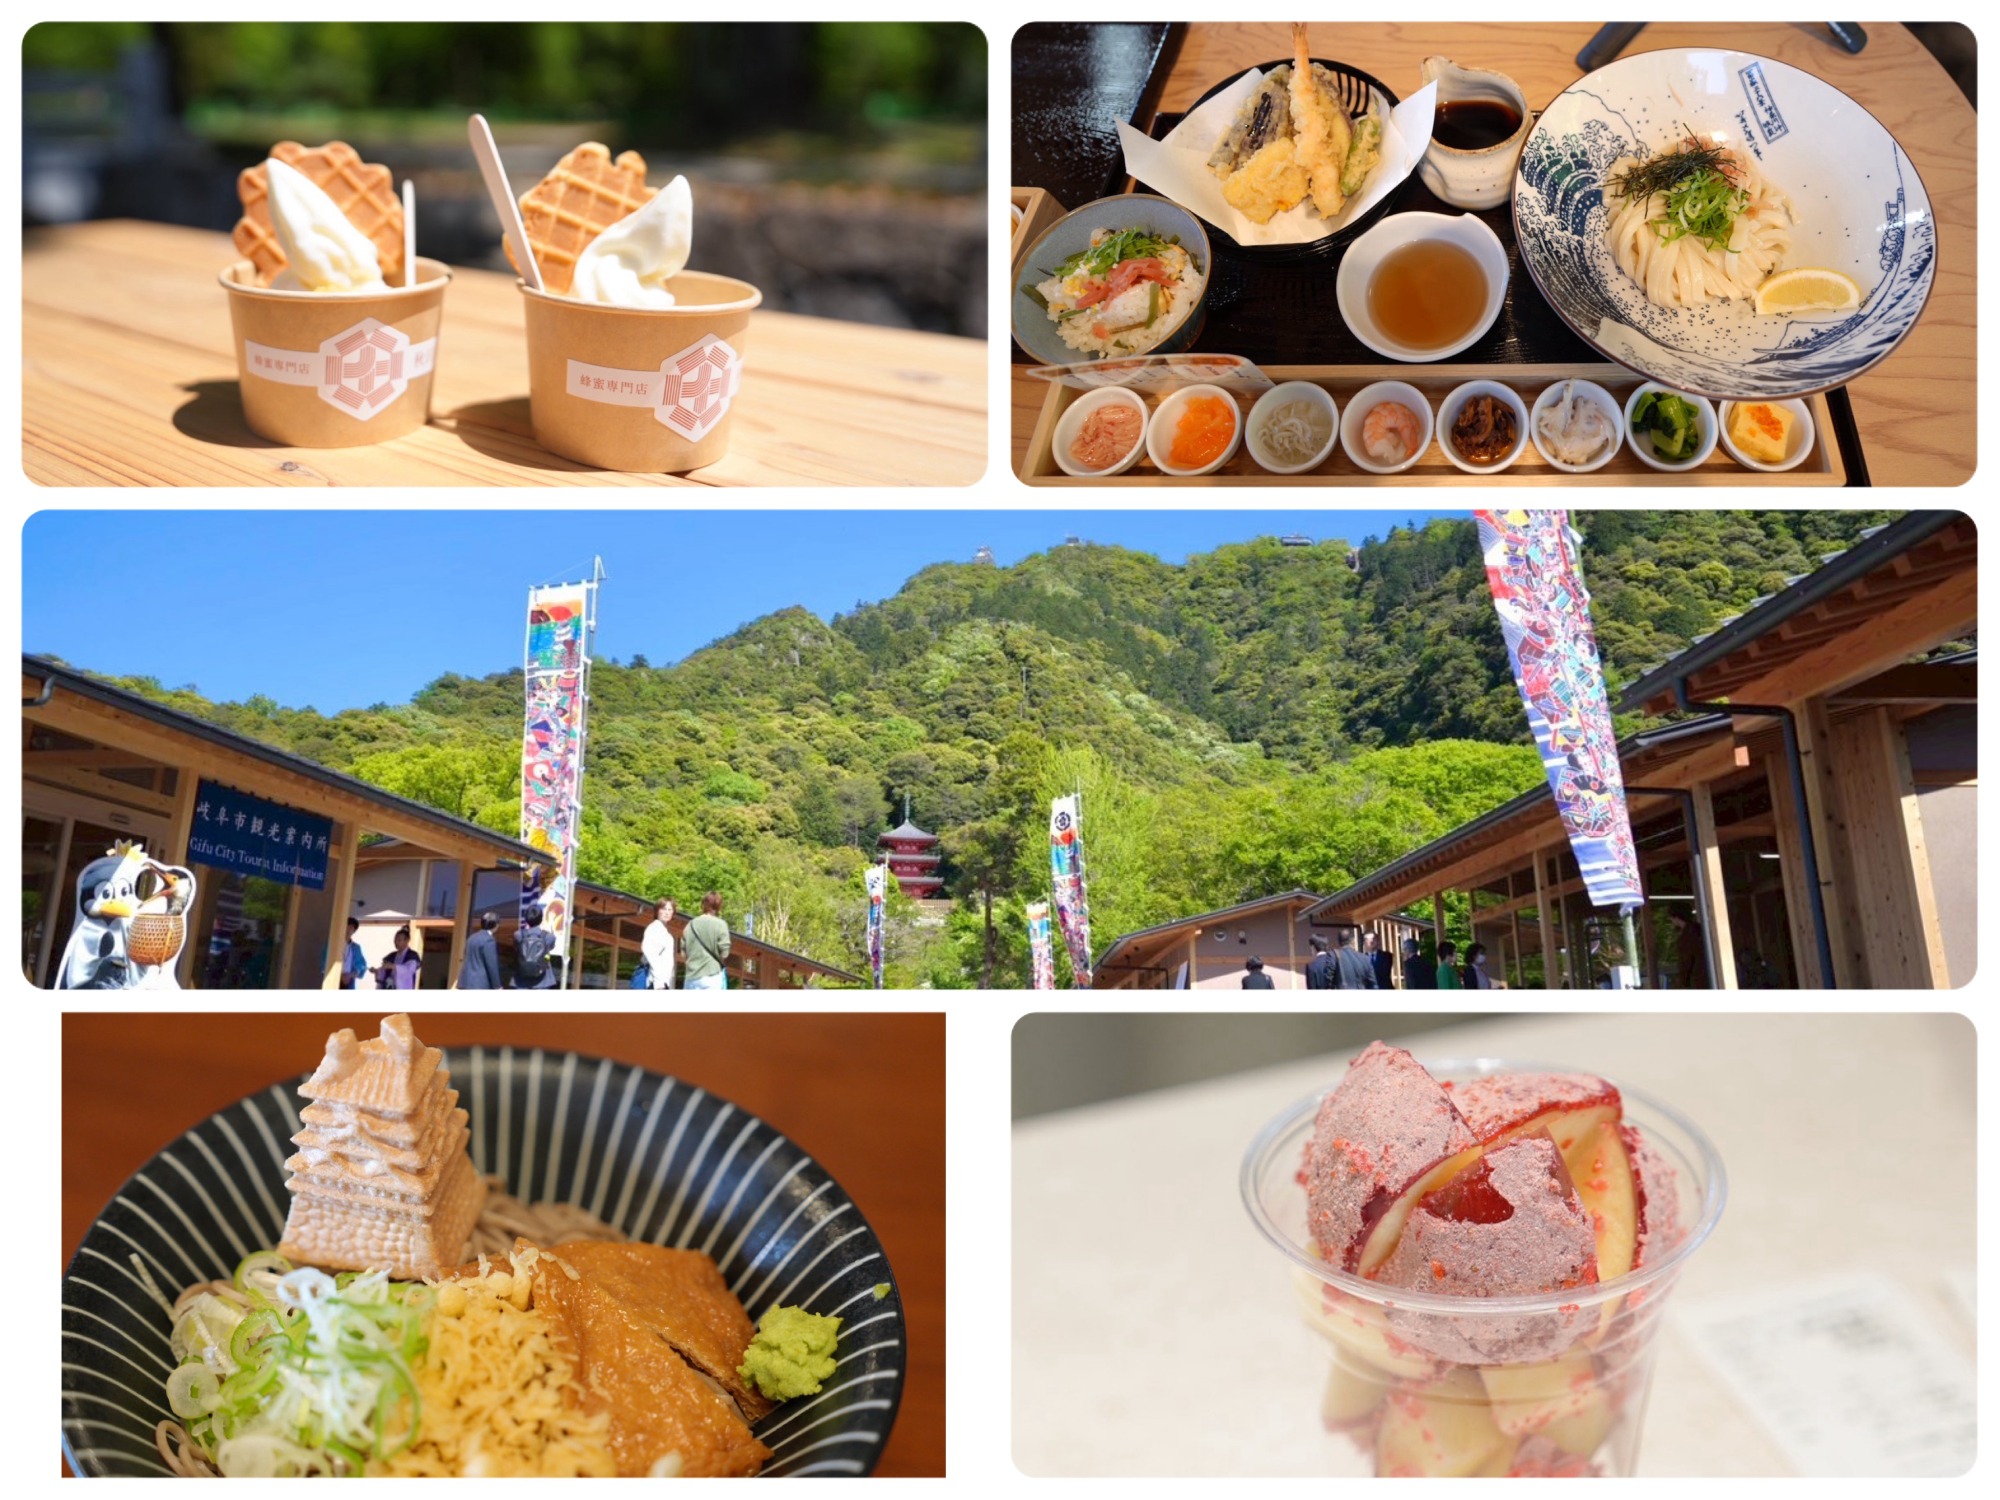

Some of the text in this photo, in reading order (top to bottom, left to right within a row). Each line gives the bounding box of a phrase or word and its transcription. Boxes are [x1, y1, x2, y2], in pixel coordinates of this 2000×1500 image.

[254, 354, 310, 375] 蜂蜜専門店
[579, 374, 649, 395] 蜂蜜専門店
[189, 837, 213, 855] Gifu
[214, 844, 236, 863] City
[272, 858, 324, 881] Information
